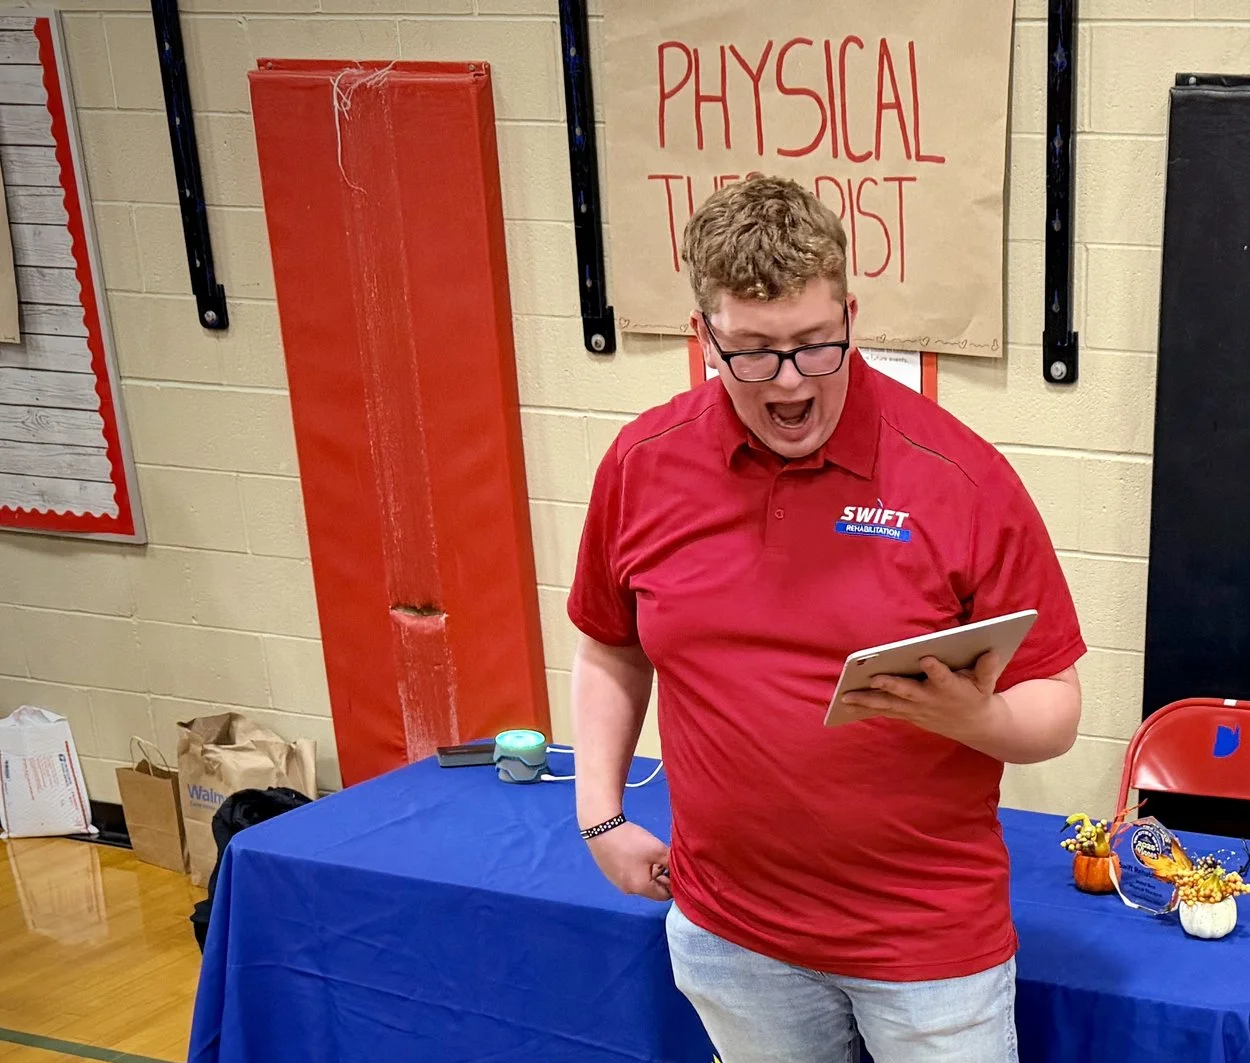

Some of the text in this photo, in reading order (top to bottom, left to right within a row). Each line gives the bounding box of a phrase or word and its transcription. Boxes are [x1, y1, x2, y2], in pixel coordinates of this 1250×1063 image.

[657, 35, 946, 163] PHYSICAL
[840, 506, 909, 527] SWIFT
[846, 524, 901, 537] REHABILITATION
